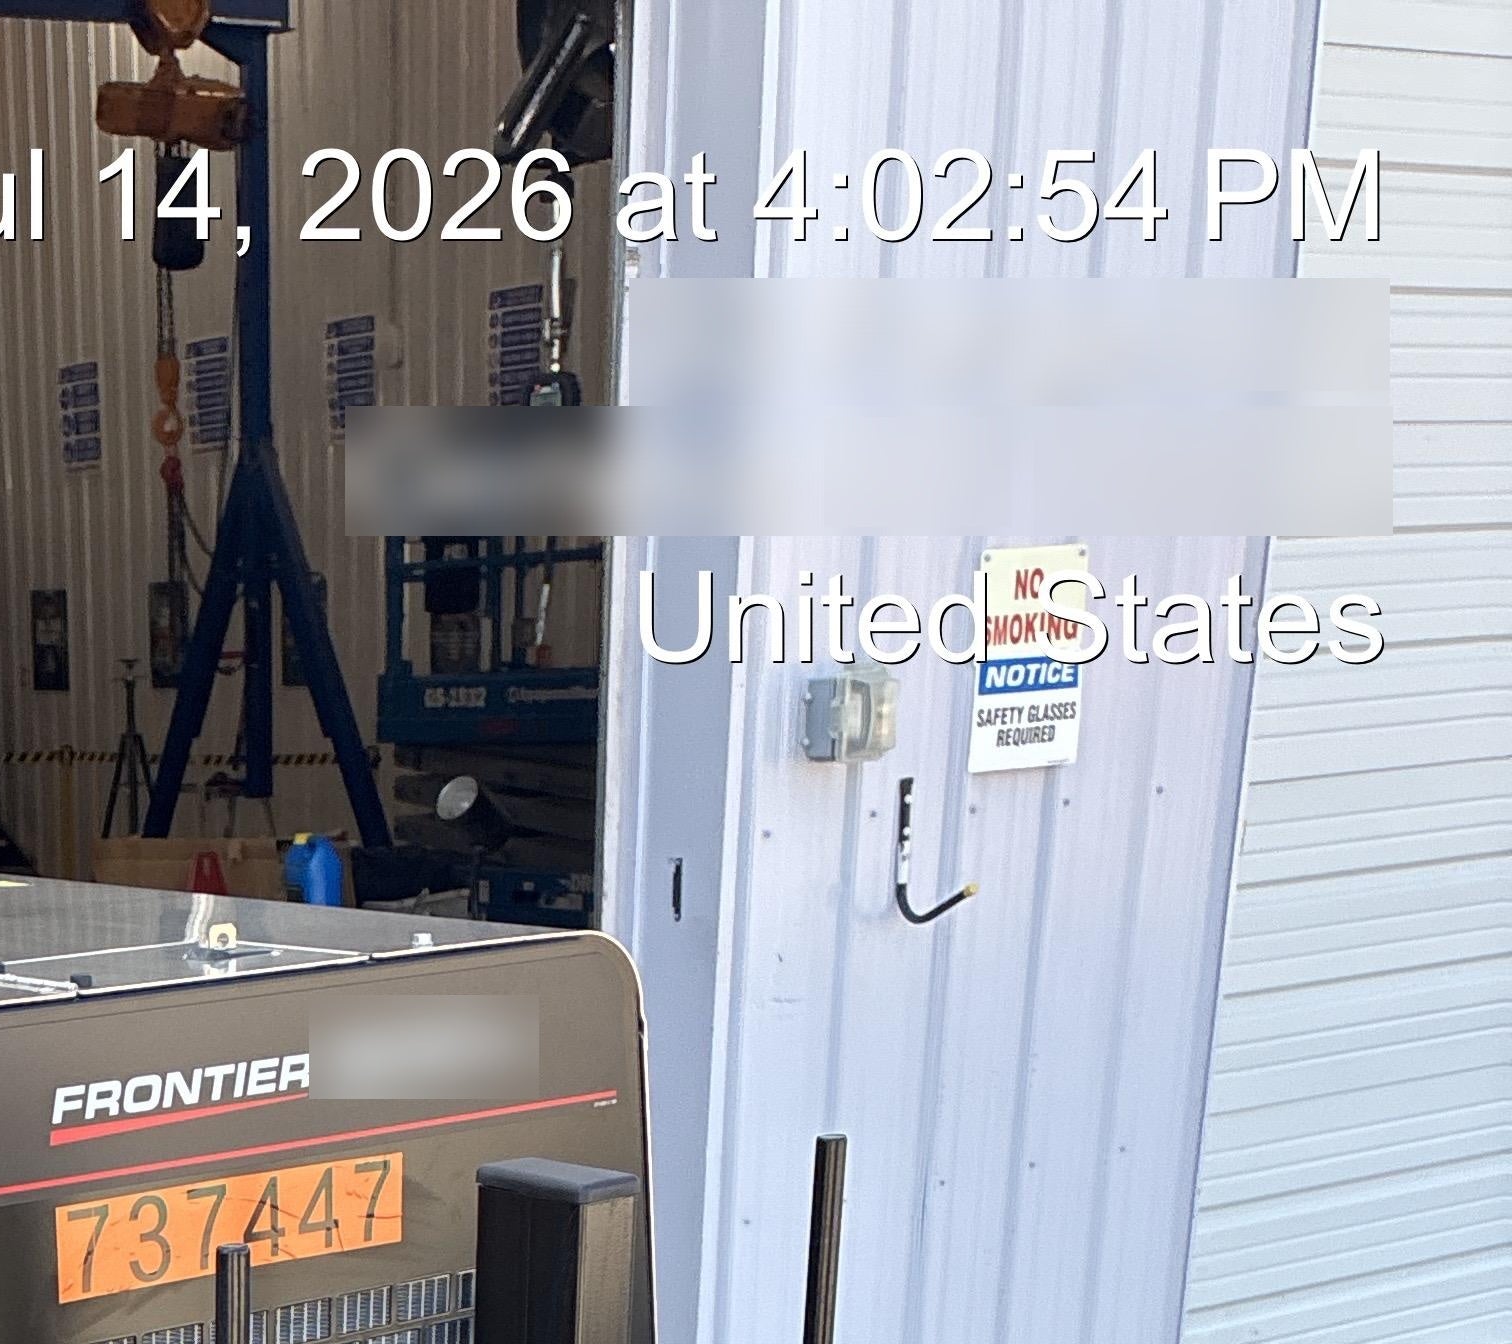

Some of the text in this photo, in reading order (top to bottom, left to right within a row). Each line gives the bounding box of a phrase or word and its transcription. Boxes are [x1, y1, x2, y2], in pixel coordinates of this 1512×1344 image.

[1014, 567, 1045, 601] NO
[985, 662, 1075, 689] NOTICE
[976, 701, 1077, 728] SAFETY GLASSES
[995, 726, 1056, 747] REQUIRED
[51, 1053, 309, 1125] FRONTIER
[67, 1159, 391, 1294] 737447
